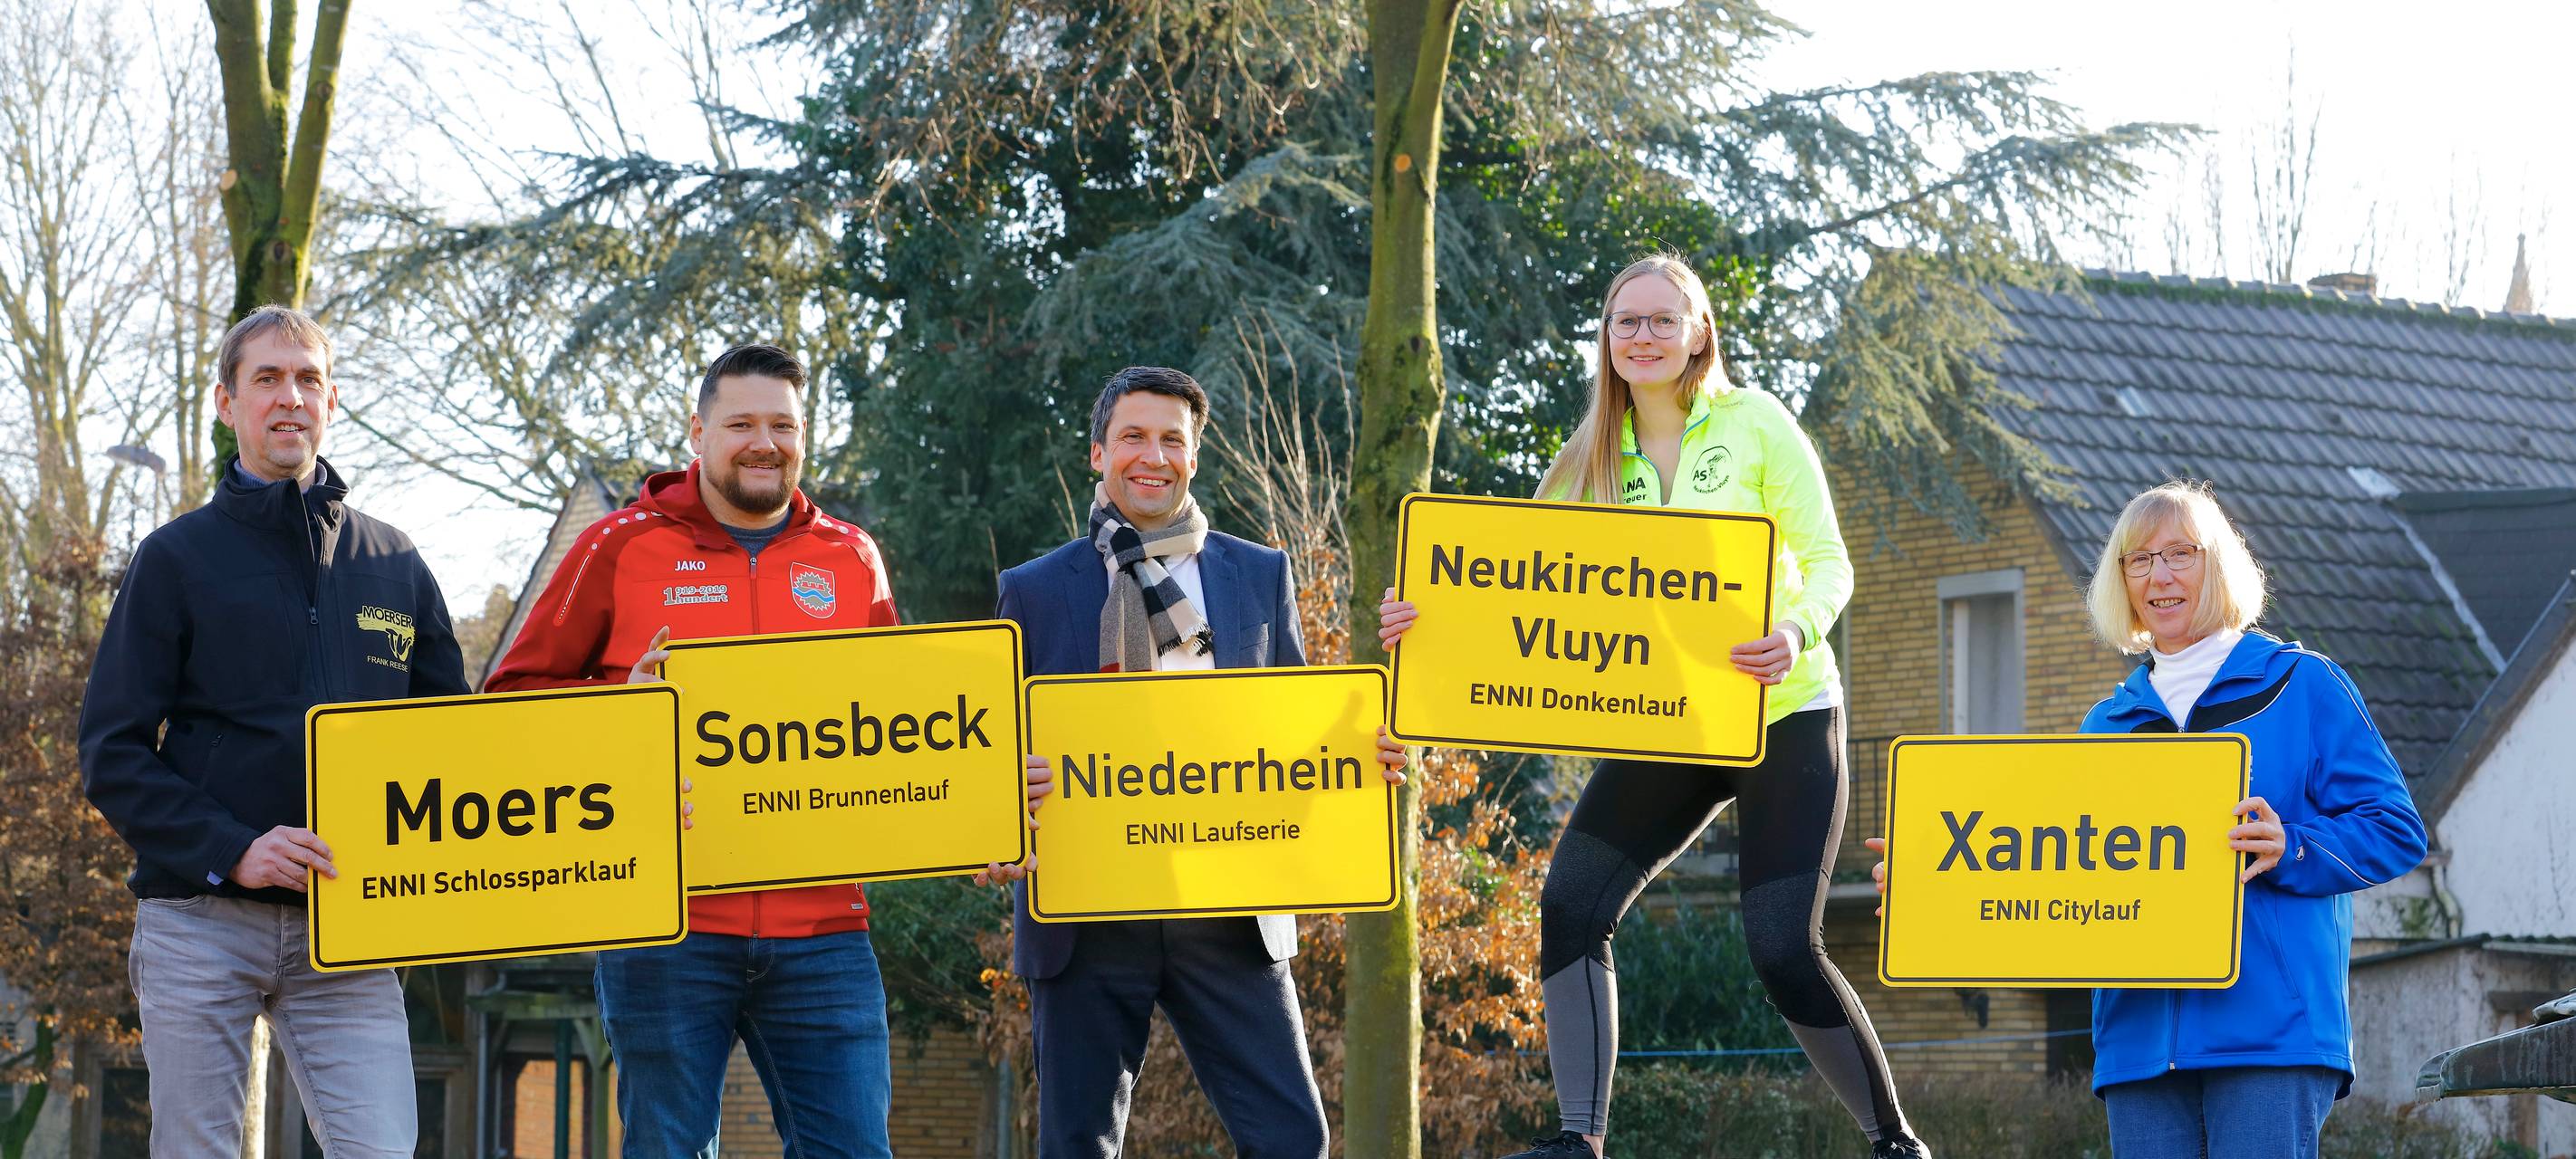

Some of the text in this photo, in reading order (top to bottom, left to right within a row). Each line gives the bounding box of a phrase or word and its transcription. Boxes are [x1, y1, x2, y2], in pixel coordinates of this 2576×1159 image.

[674, 560, 706, 571] JAKO
[1430, 544, 1742, 602] Neukirchen-
[362, 605, 413, 628] MOERSER
[367, 655, 409, 673] FRANK REESE
[1512, 616, 1649, 673] Vluyn
[1470, 683, 1687, 717] ENNI Donkenlauf
[695, 694, 992, 768] Sonsbeck
[1062, 745, 1362, 799] Niederrhein
[385, 778, 616, 846] Moers
[743, 779, 949, 815] ENNI Brunnenlauf
[1126, 820, 1301, 845] ENNI Laufserie
[1936, 810, 2187, 872] Xanten
[362, 857, 638, 900] ENNI Schlossparklauf
[1980, 899, 2141, 925] ENNI Citylauf
